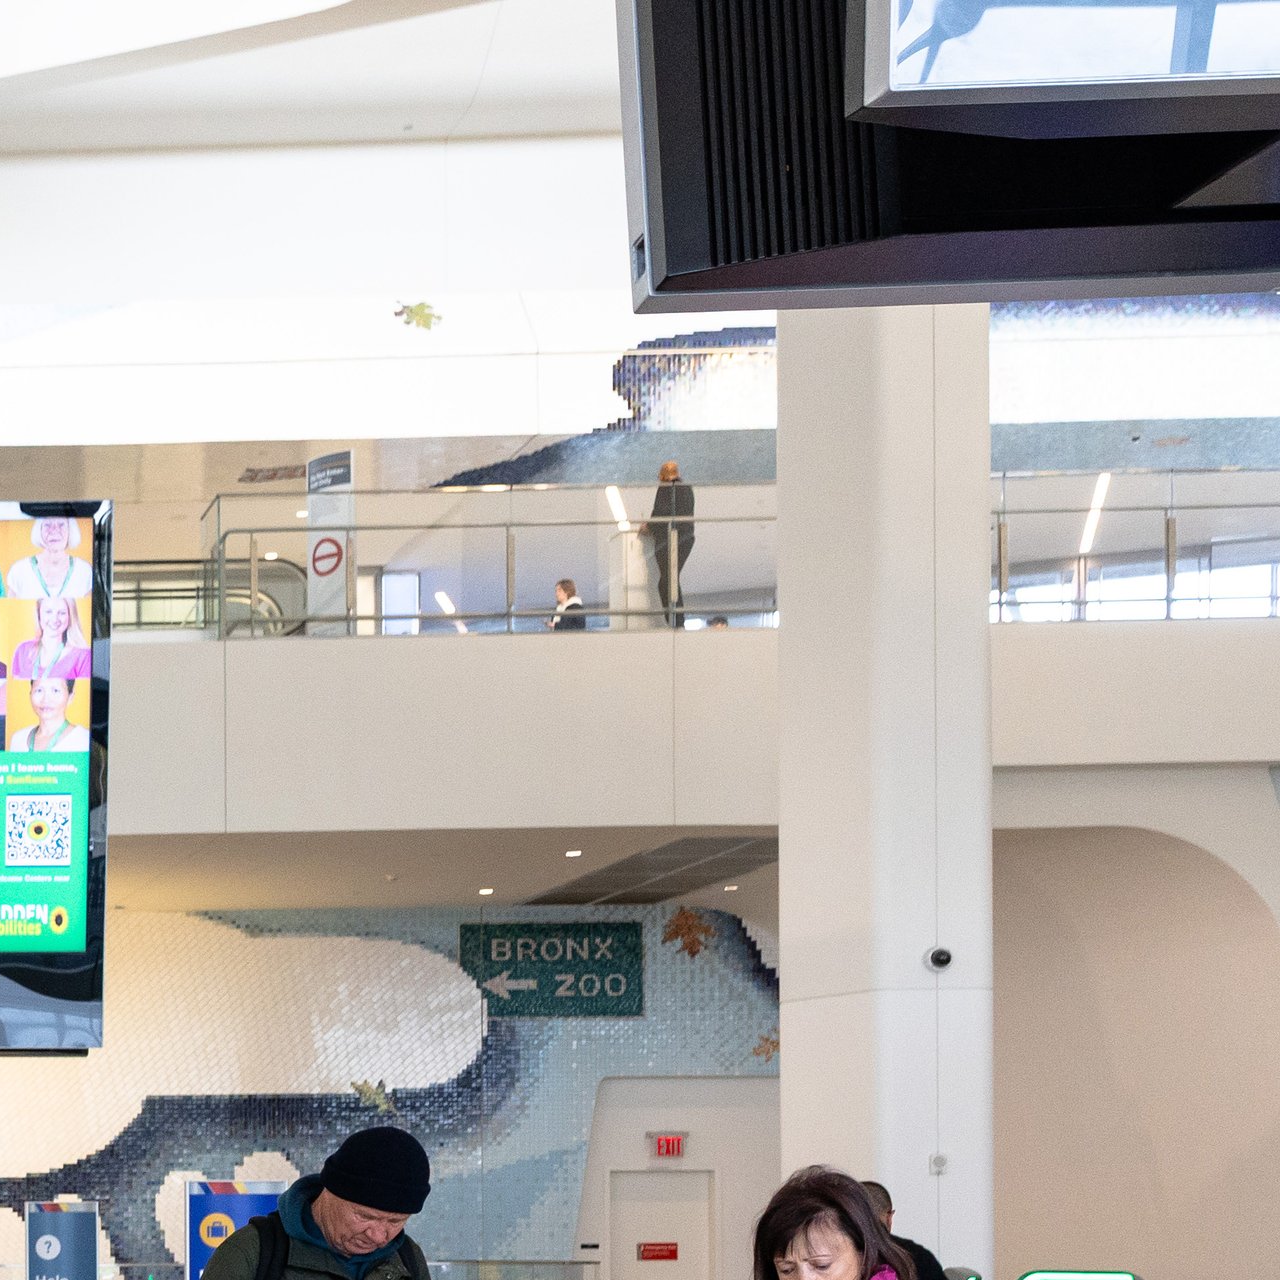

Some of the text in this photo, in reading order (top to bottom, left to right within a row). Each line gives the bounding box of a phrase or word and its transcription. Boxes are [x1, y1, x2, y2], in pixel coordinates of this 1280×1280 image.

[491, 937, 613, 961] BRONX
[554, 973, 627, 997] ZOO
[657, 1136, 682, 1157] EXIT
